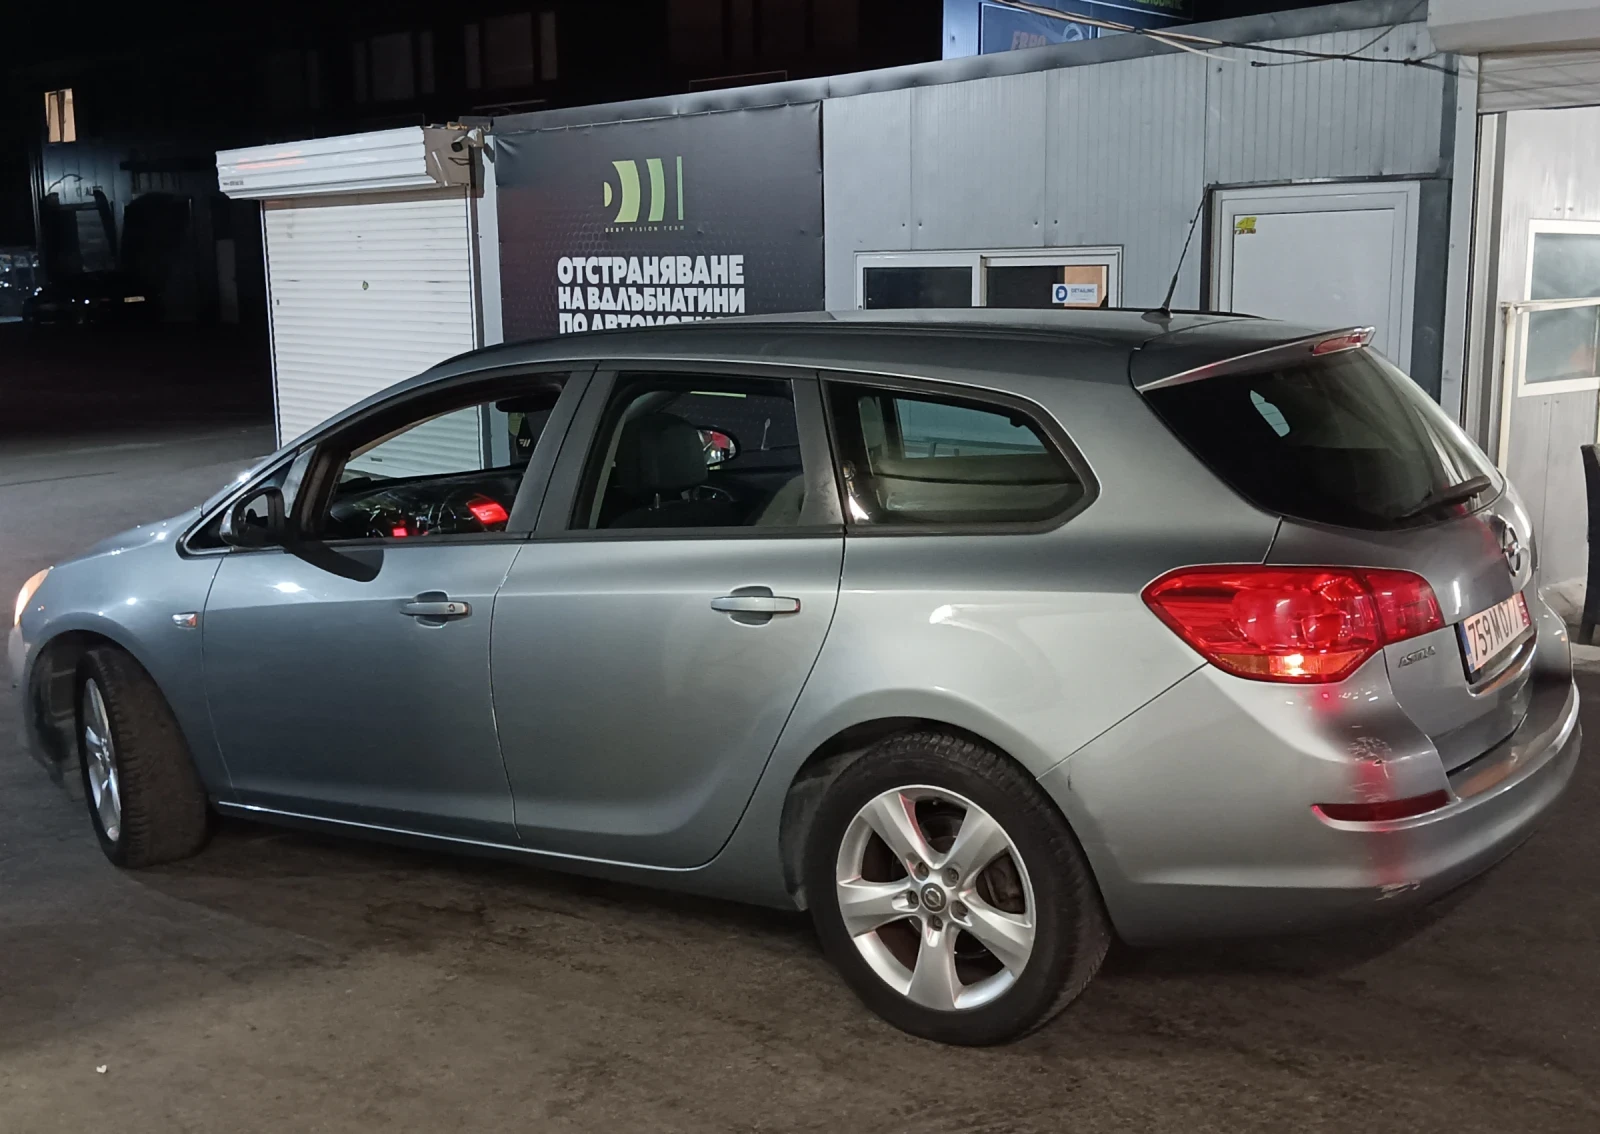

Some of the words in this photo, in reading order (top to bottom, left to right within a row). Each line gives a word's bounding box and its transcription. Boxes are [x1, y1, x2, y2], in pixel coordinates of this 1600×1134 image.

[557, 255, 745, 285] ОТСТРАНЯВАНЕ
[558, 286, 585, 310] НА
[587, 287, 745, 313] ВДЛЪБНАТИНИ
[559, 313, 588, 334] ПО
[1398, 645, 1436, 668] ASTRA
